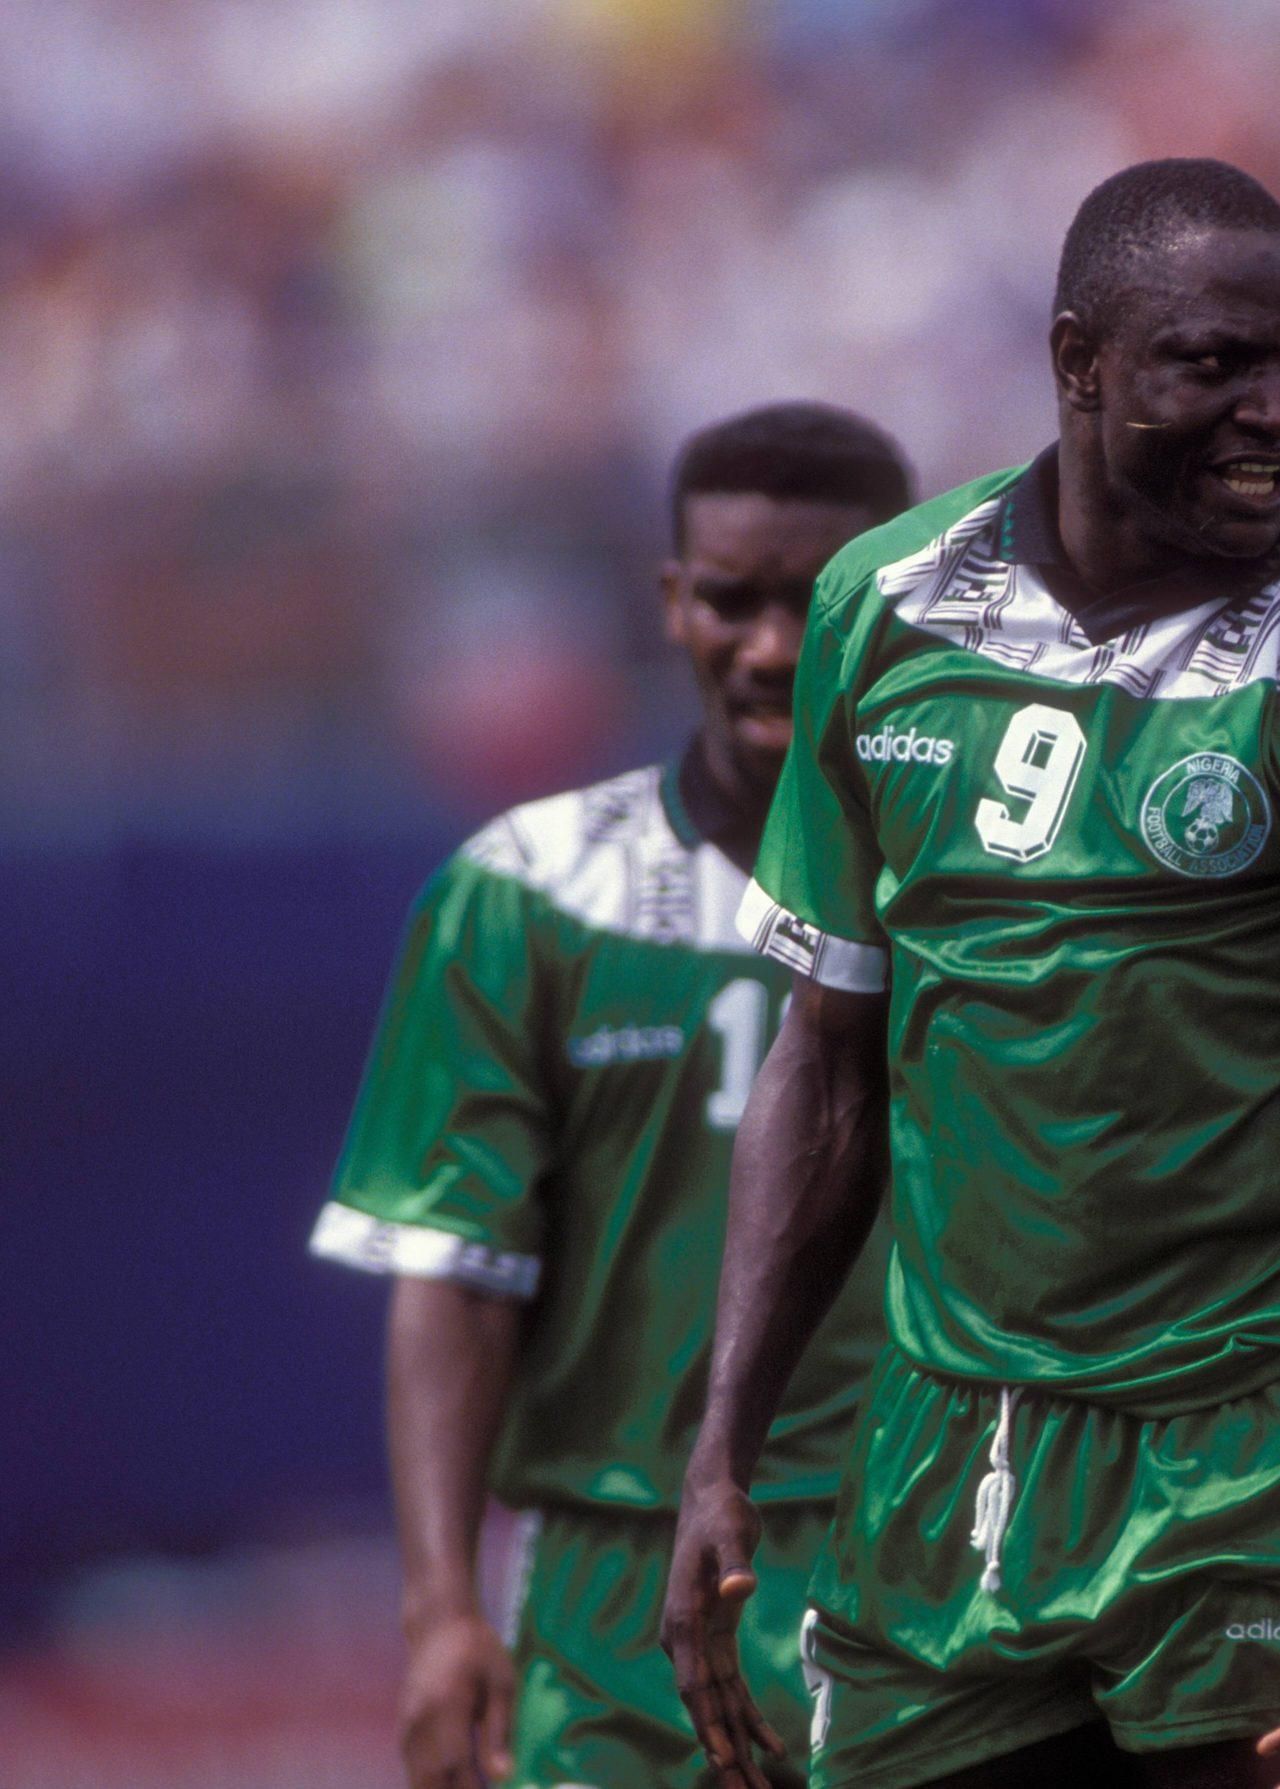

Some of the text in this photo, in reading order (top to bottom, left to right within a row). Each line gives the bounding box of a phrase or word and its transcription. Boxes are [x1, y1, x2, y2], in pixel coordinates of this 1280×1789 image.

[855, 724, 955, 766] adidas
[1185, 756, 1241, 785] NIGERIA
[974, 702, 1088, 864] 9
[1146, 805, 1182, 867] FOOTBALL
[707, 976, 792, 1130] 1
